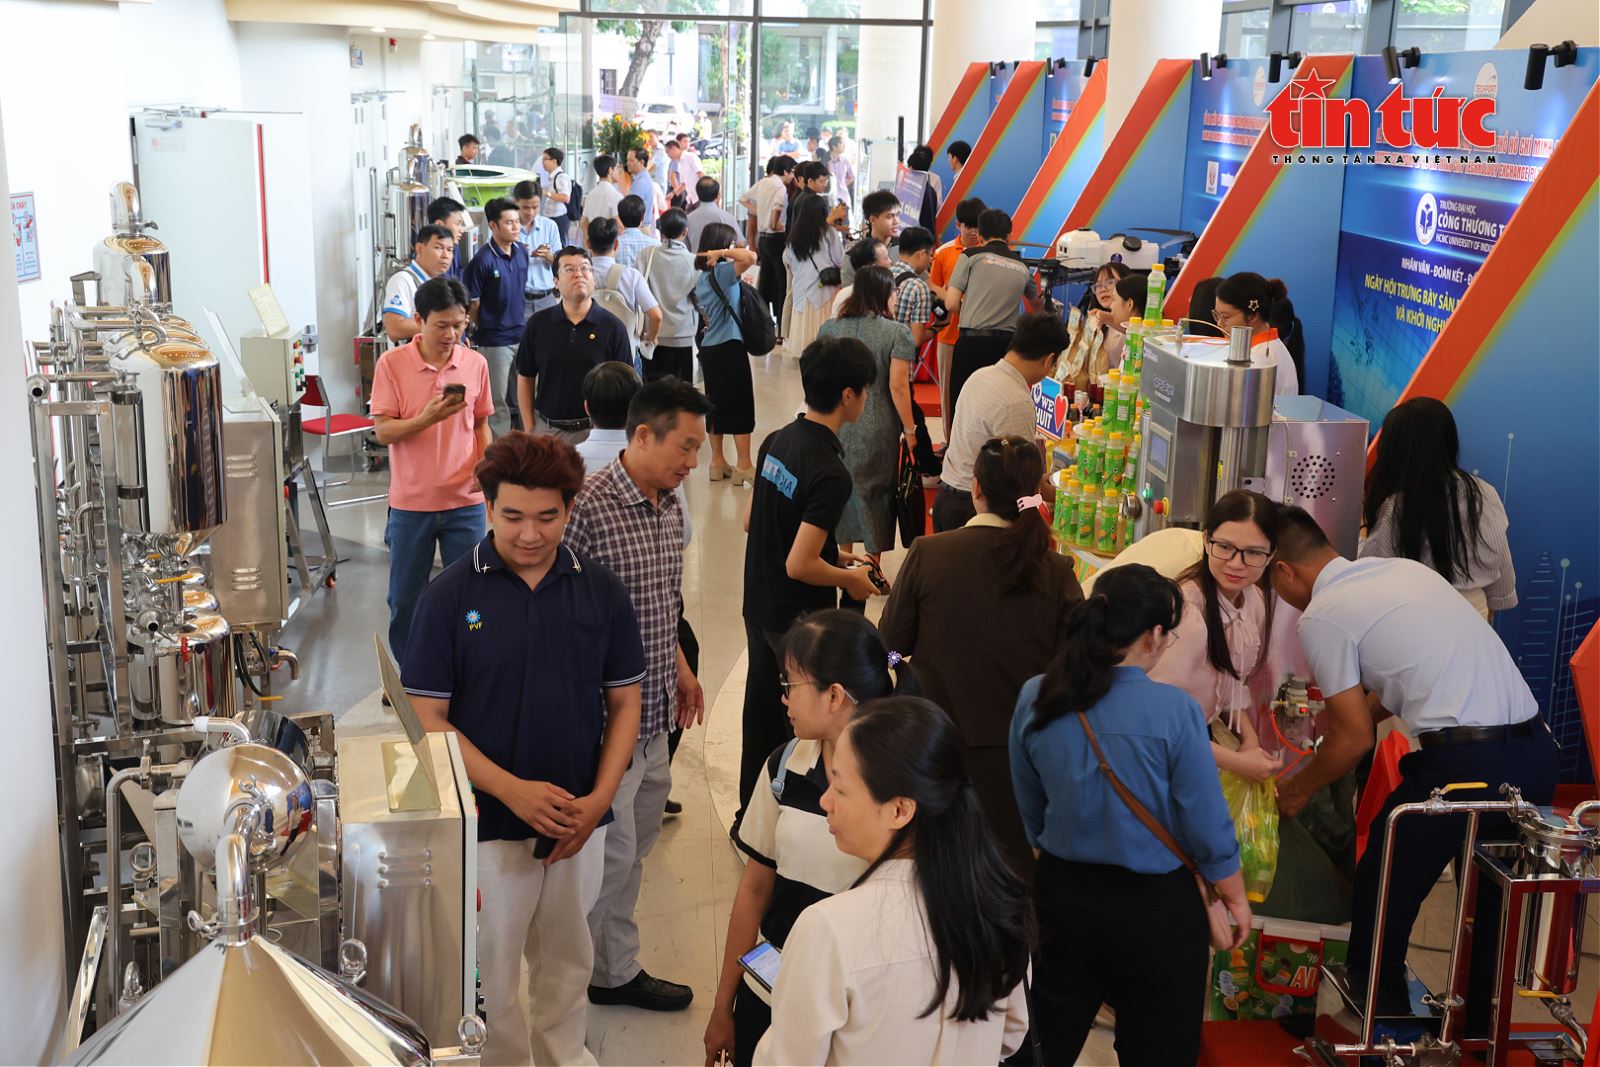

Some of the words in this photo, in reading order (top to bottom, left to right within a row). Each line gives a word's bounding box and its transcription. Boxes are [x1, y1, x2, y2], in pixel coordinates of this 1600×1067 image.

[1437, 211, 1460, 230] CÔNG
[1461, 217, 1497, 238] THƯƠNG
[1401, 257, 1418, 272] NHÂN
[1433, 265, 1452, 281] ĐOÀN
[1452, 267, 1464, 284] KẾT
[1365, 273, 1384, 292] NGÀY
[1383, 278, 1397, 299] HỘI
[1397, 282, 1422, 303] TRƯNG
[1422, 288, 1438, 308] BÀY
[1437, 291, 1456, 313] SẢN
[1396, 304, 1405, 322] VÀ
[1405, 308, 1425, 328] KHỞI
[1041, 395, 1054, 413] WE
